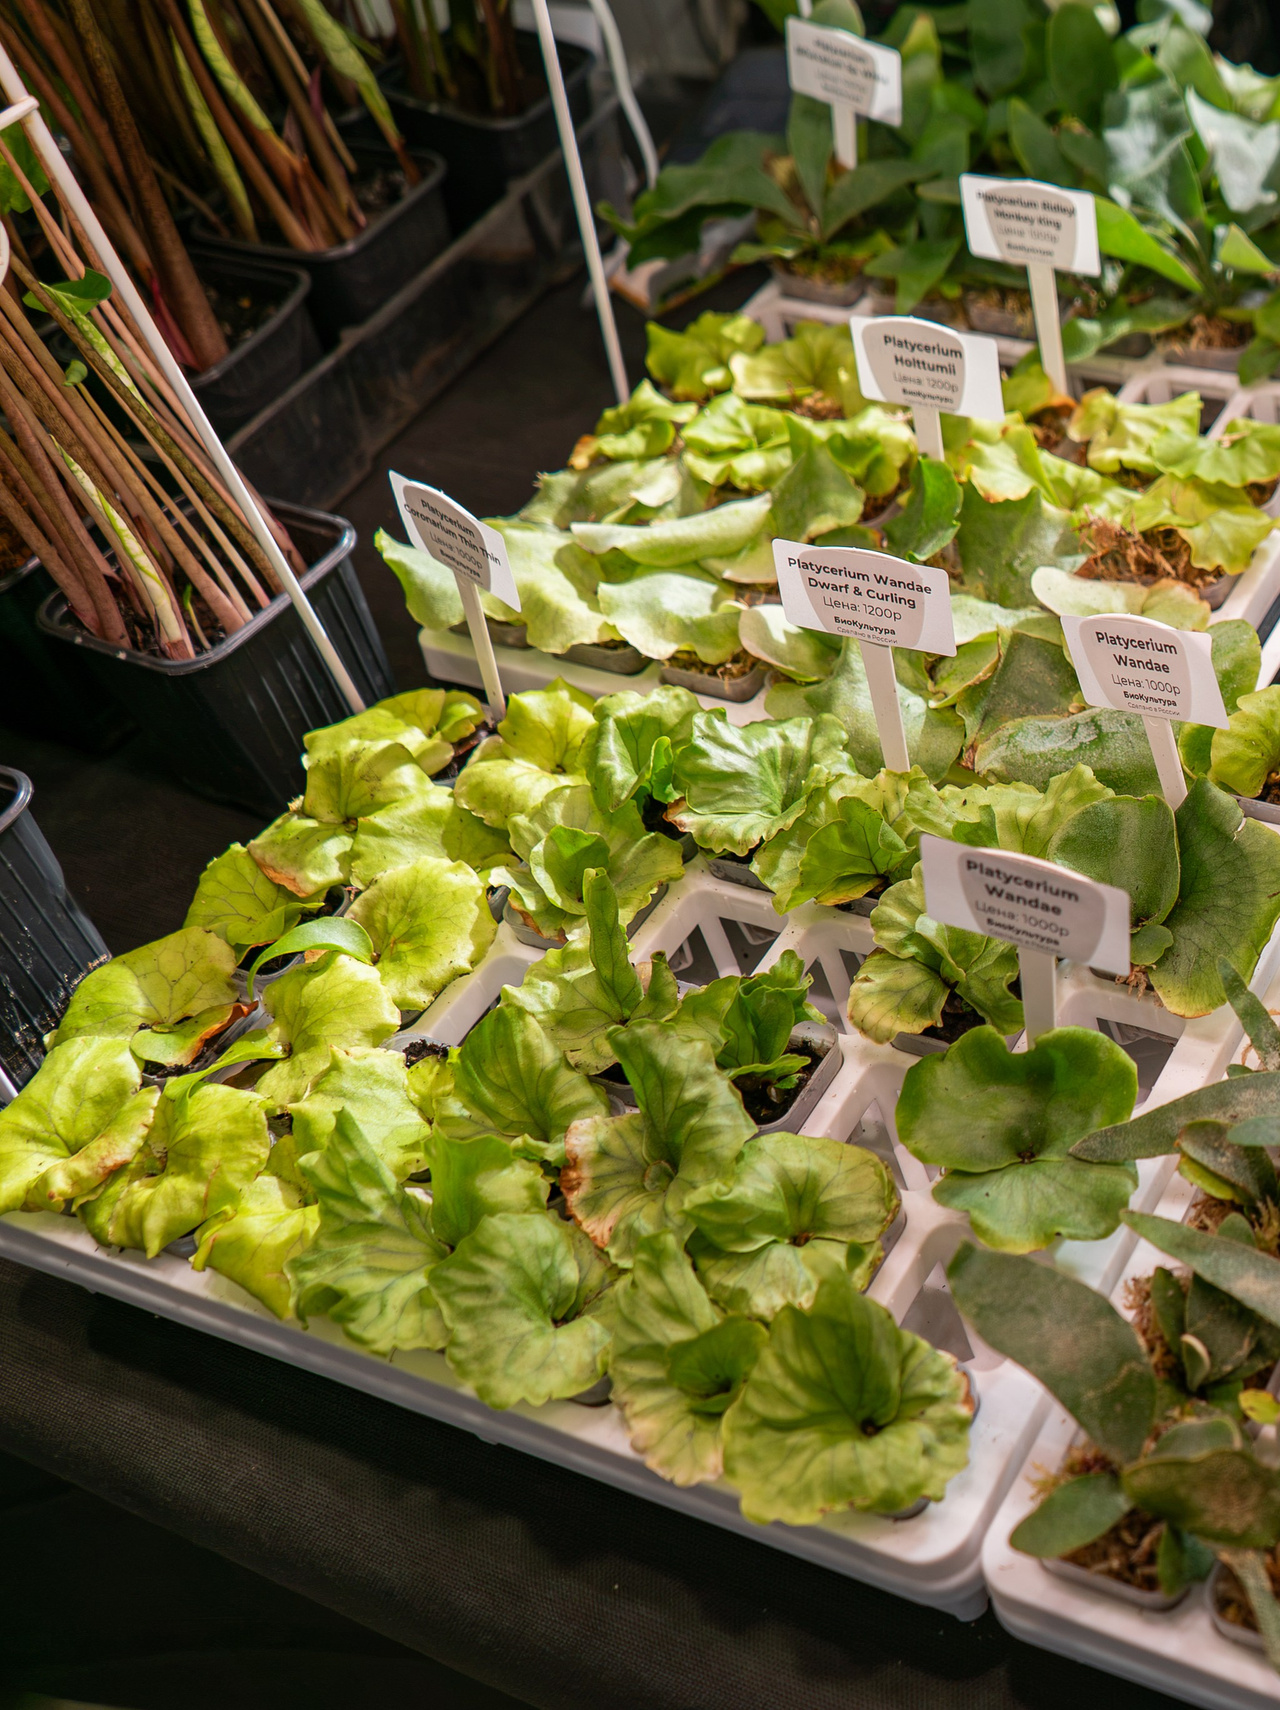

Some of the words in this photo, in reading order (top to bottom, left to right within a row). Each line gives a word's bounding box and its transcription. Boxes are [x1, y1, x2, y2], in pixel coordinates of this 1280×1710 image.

[883, 333, 962, 359] Platycerium
[894, 354, 956, 376] Holttumii
[421, 499, 475, 538] Platycerium
[404, 504, 457, 540] Coronarium
[458, 534, 479, 552] Thin
[480, 546, 501, 566] Thin
[787, 557, 870, 582] Platycerium
[873, 573, 932, 594] Wandae
[808, 577, 849, 594] Dwarf
[853, 586, 863, 597] &
[866, 589, 916, 609] Curling
[823, 595, 861, 612] Цена:
[863, 604, 902, 622] 1200р
[834, 616, 896, 636] БиоКультура
[1095, 631, 1178, 655] Platycerium
[1113, 653, 1170, 673] Wandae
[1111, 674, 1145, 689] Цена:
[1145, 678, 1181, 697] 1000р
[1123, 691, 1177, 707] БиоКультура
[966, 859, 1079, 902] Platycerium
[984, 883, 1062, 915] Wandae
[975, 900, 1019, 921] Цена:
[1022, 912, 1070, 937] 1000р
